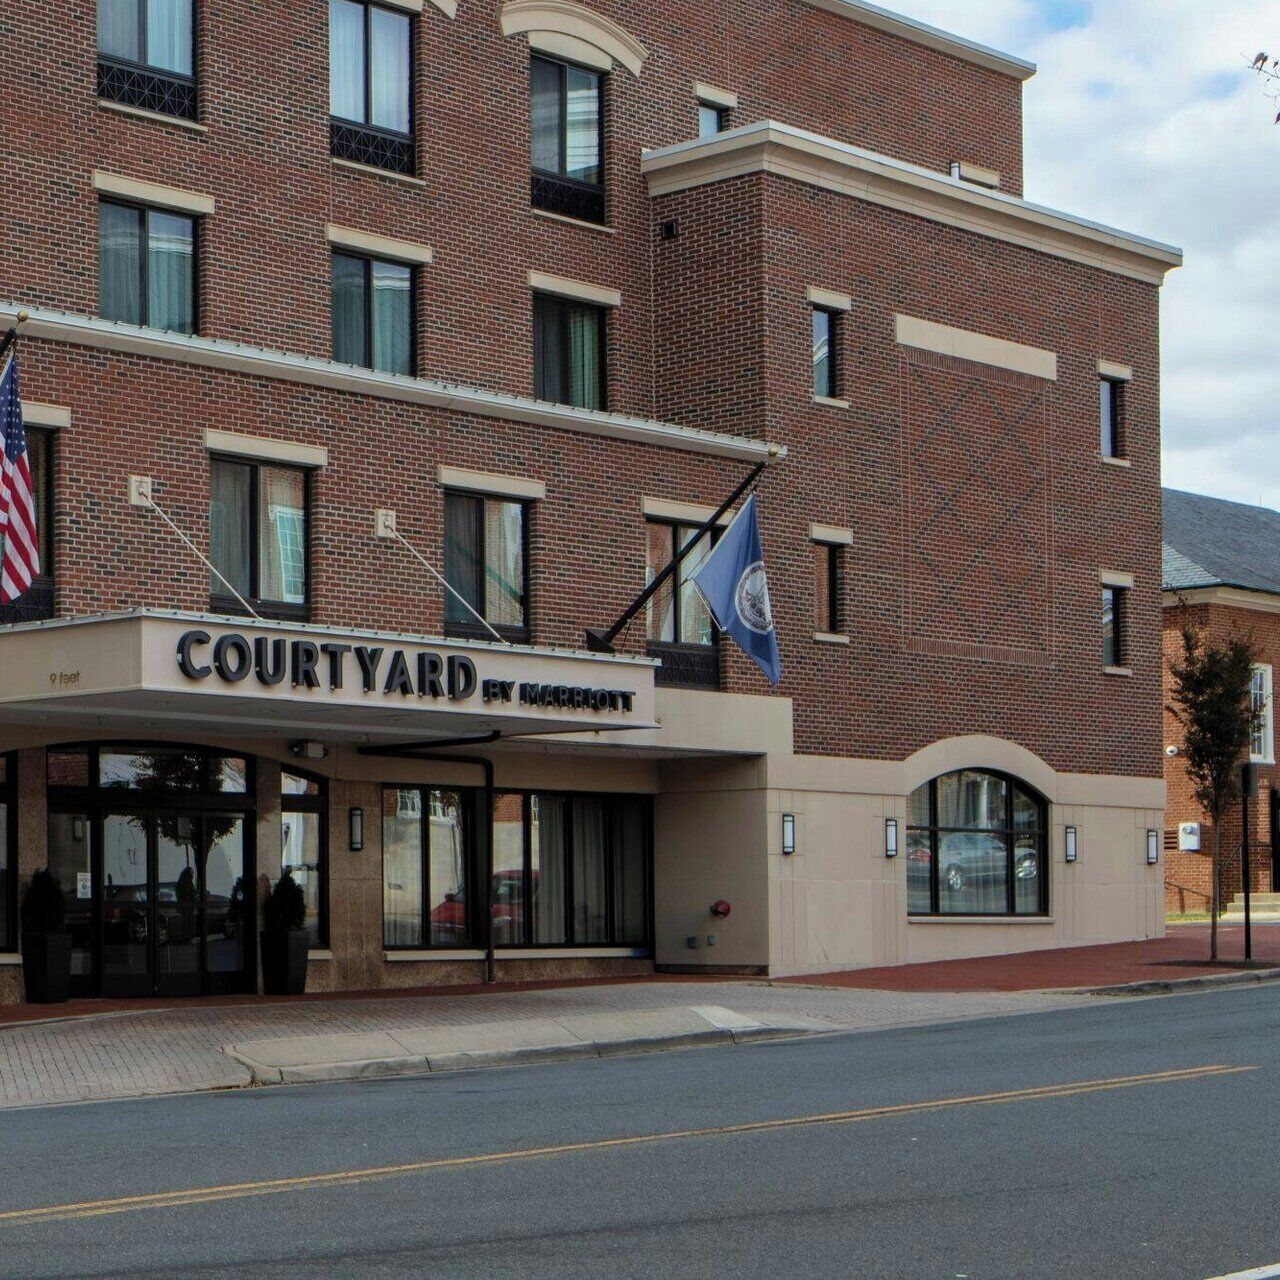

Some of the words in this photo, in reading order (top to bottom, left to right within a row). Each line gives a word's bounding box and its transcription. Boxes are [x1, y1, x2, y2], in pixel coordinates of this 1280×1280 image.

[176, 629, 478, 701] COURTYARD
[482, 679, 516, 704] BY
[519, 682, 637, 714] MARRIOTT
